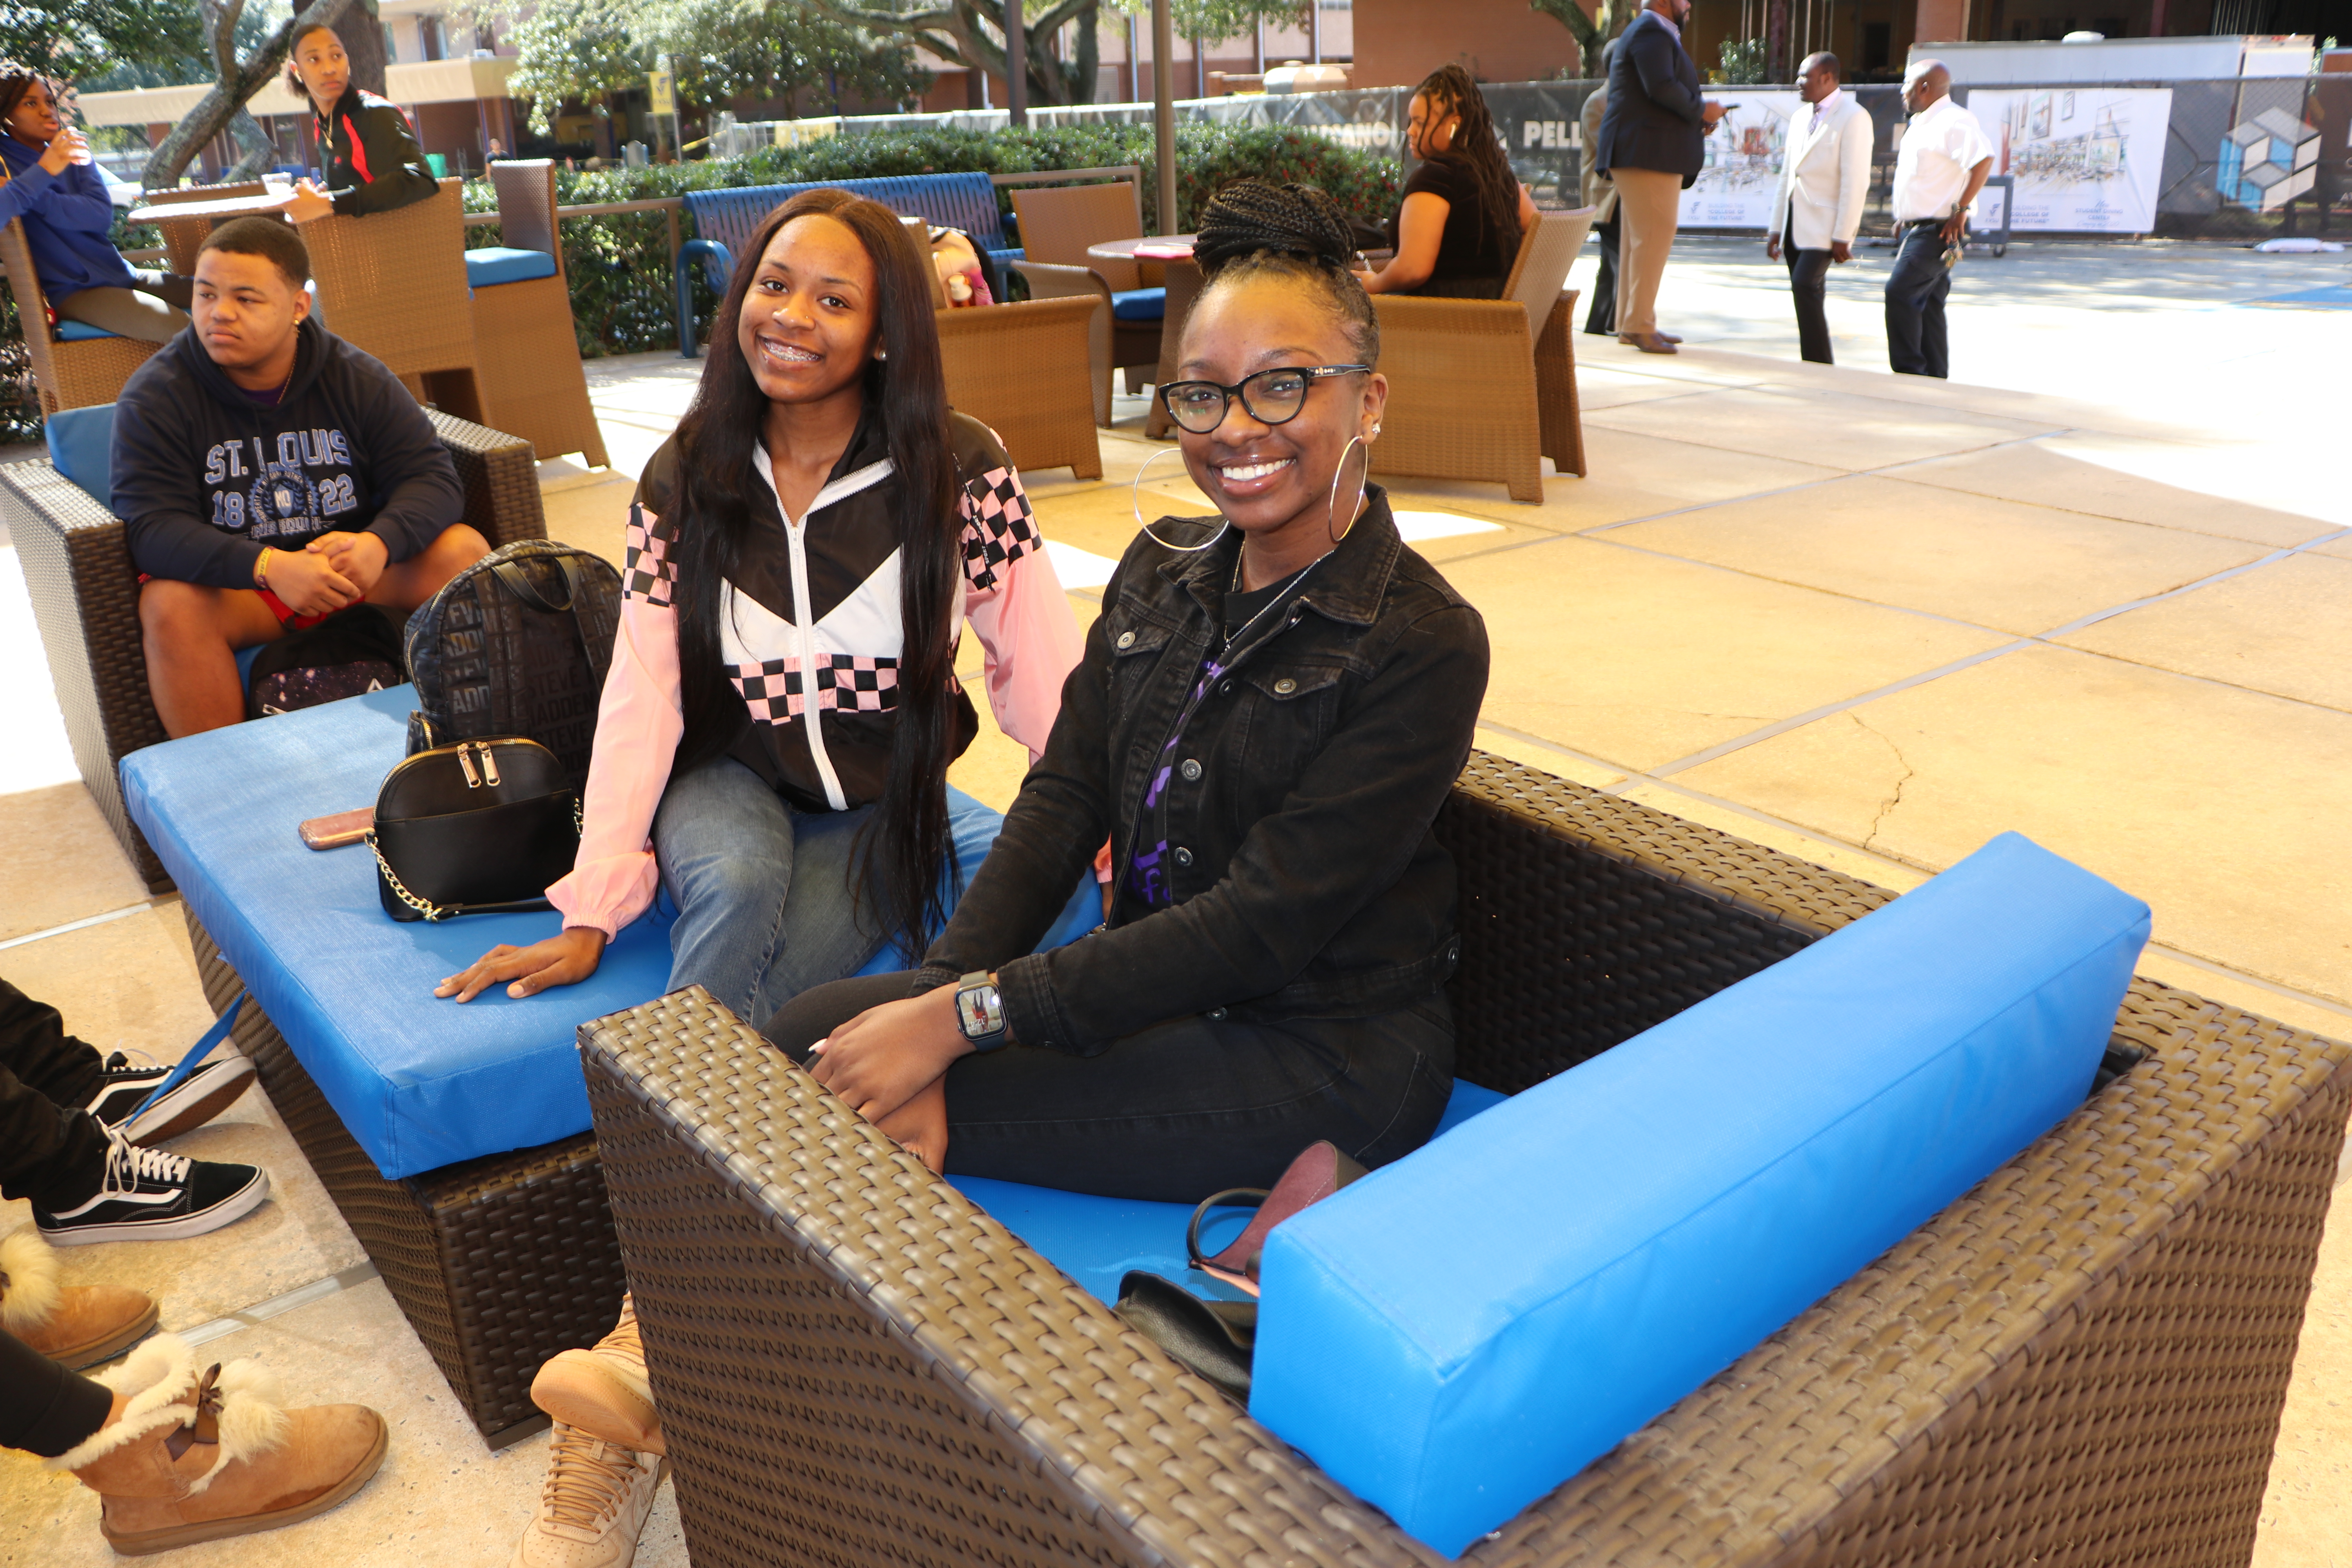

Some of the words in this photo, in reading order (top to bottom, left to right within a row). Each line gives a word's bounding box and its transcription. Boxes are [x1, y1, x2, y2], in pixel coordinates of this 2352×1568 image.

[205, 439, 250, 485] ST.
[253, 428, 352, 471] LOUIS
[212, 490, 245, 528] 18
[319, 473, 357, 517] 22
[982, 545, 990, 564] SPORT
[967, 1018, 985, 1029] 12:47
